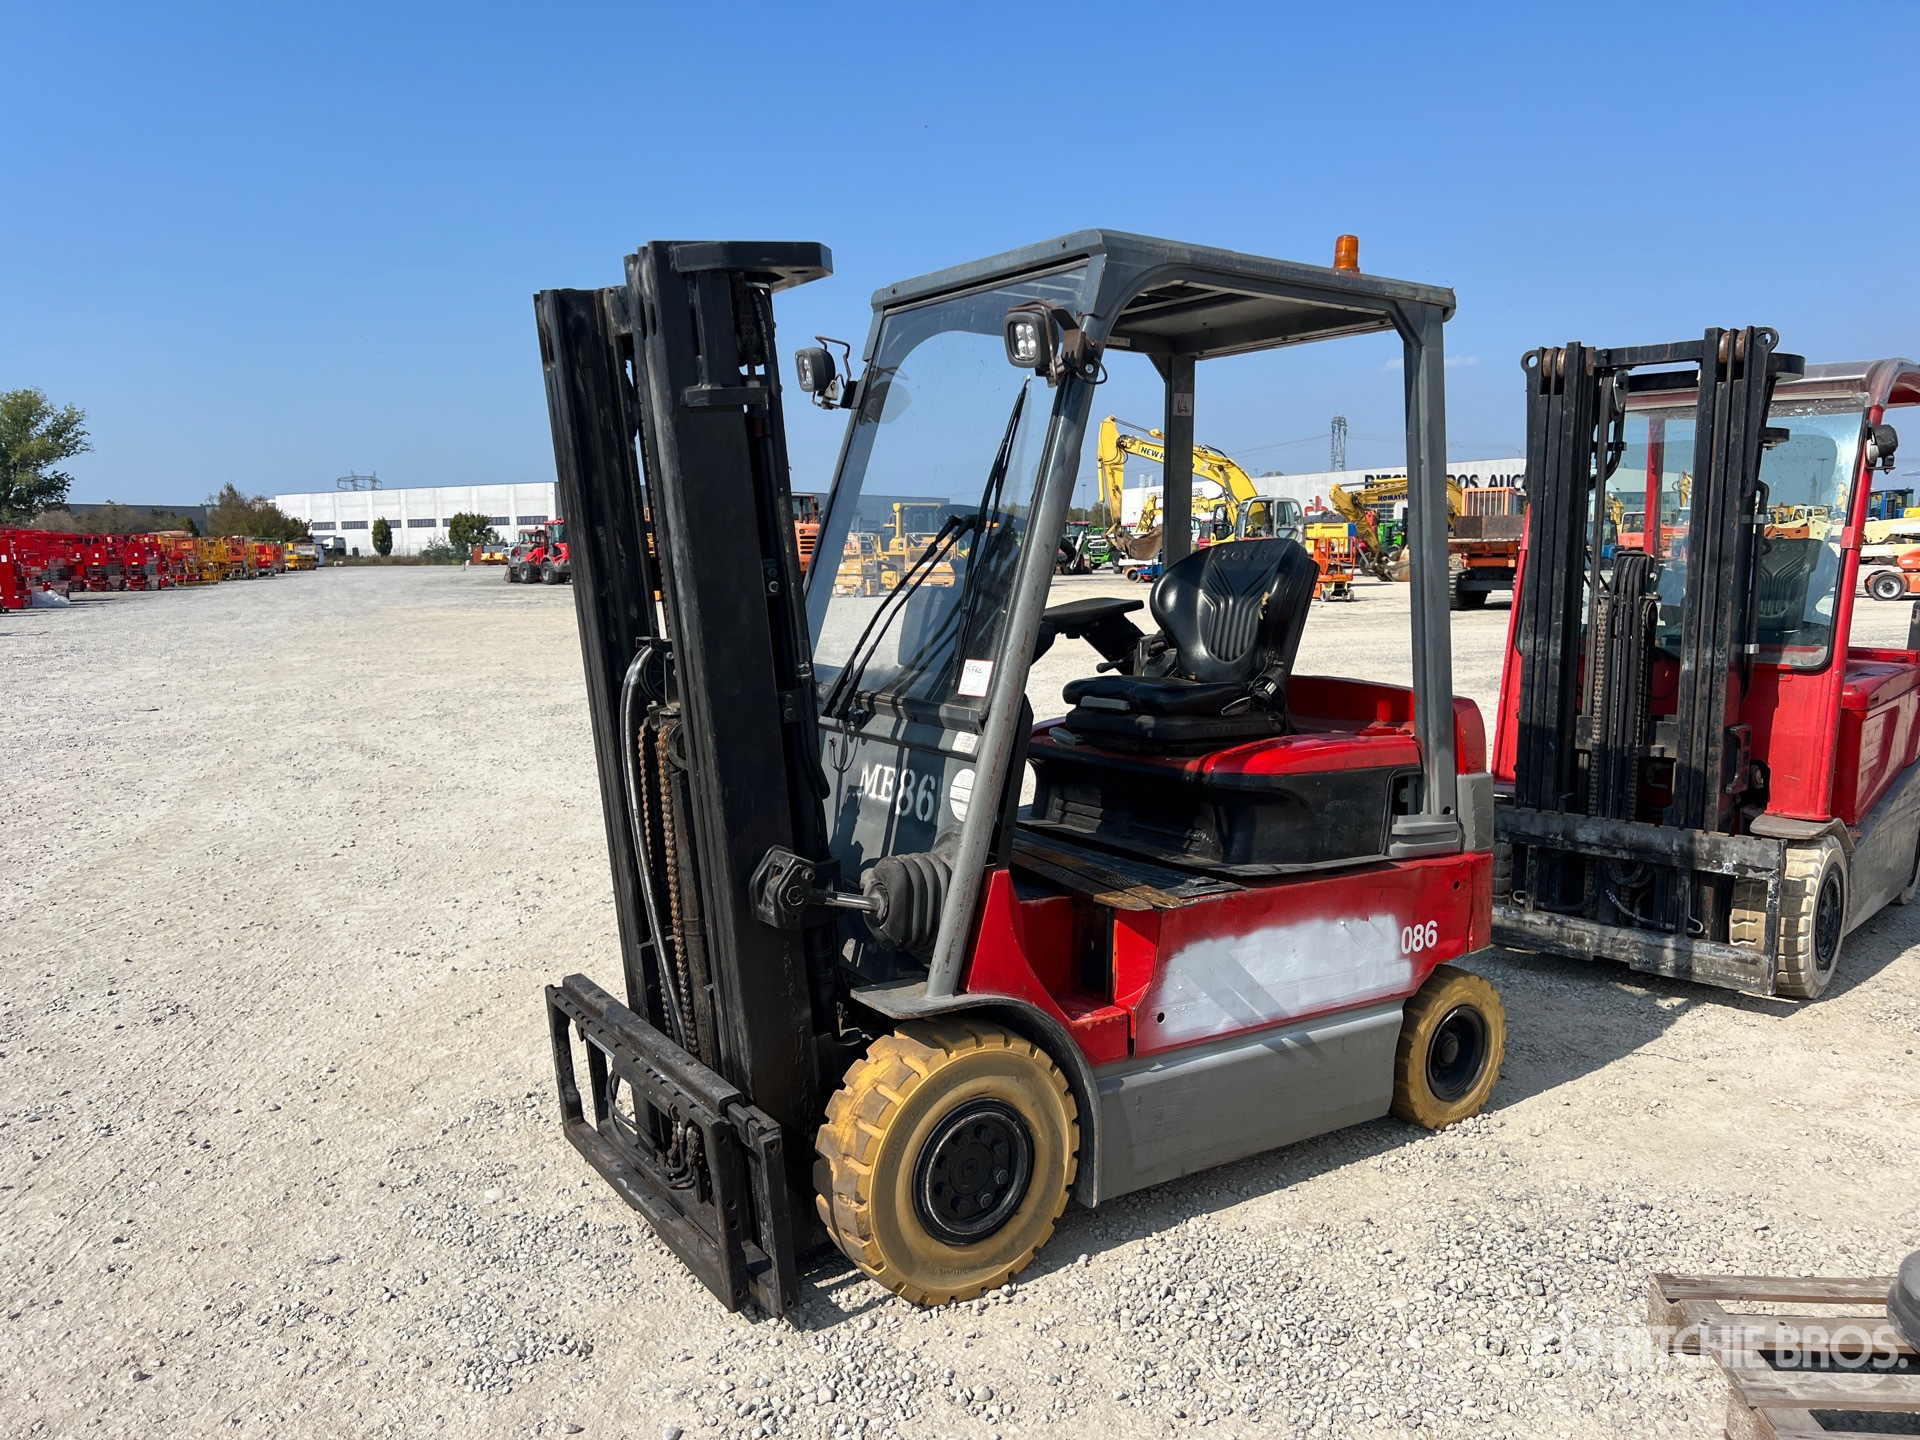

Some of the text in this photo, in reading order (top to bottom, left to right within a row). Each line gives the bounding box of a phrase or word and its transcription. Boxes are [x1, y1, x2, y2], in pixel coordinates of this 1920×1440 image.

[1140, 446, 1159, 457] NEW
[859, 761, 936, 822] ME86
[1401, 920, 1438, 954] 086
